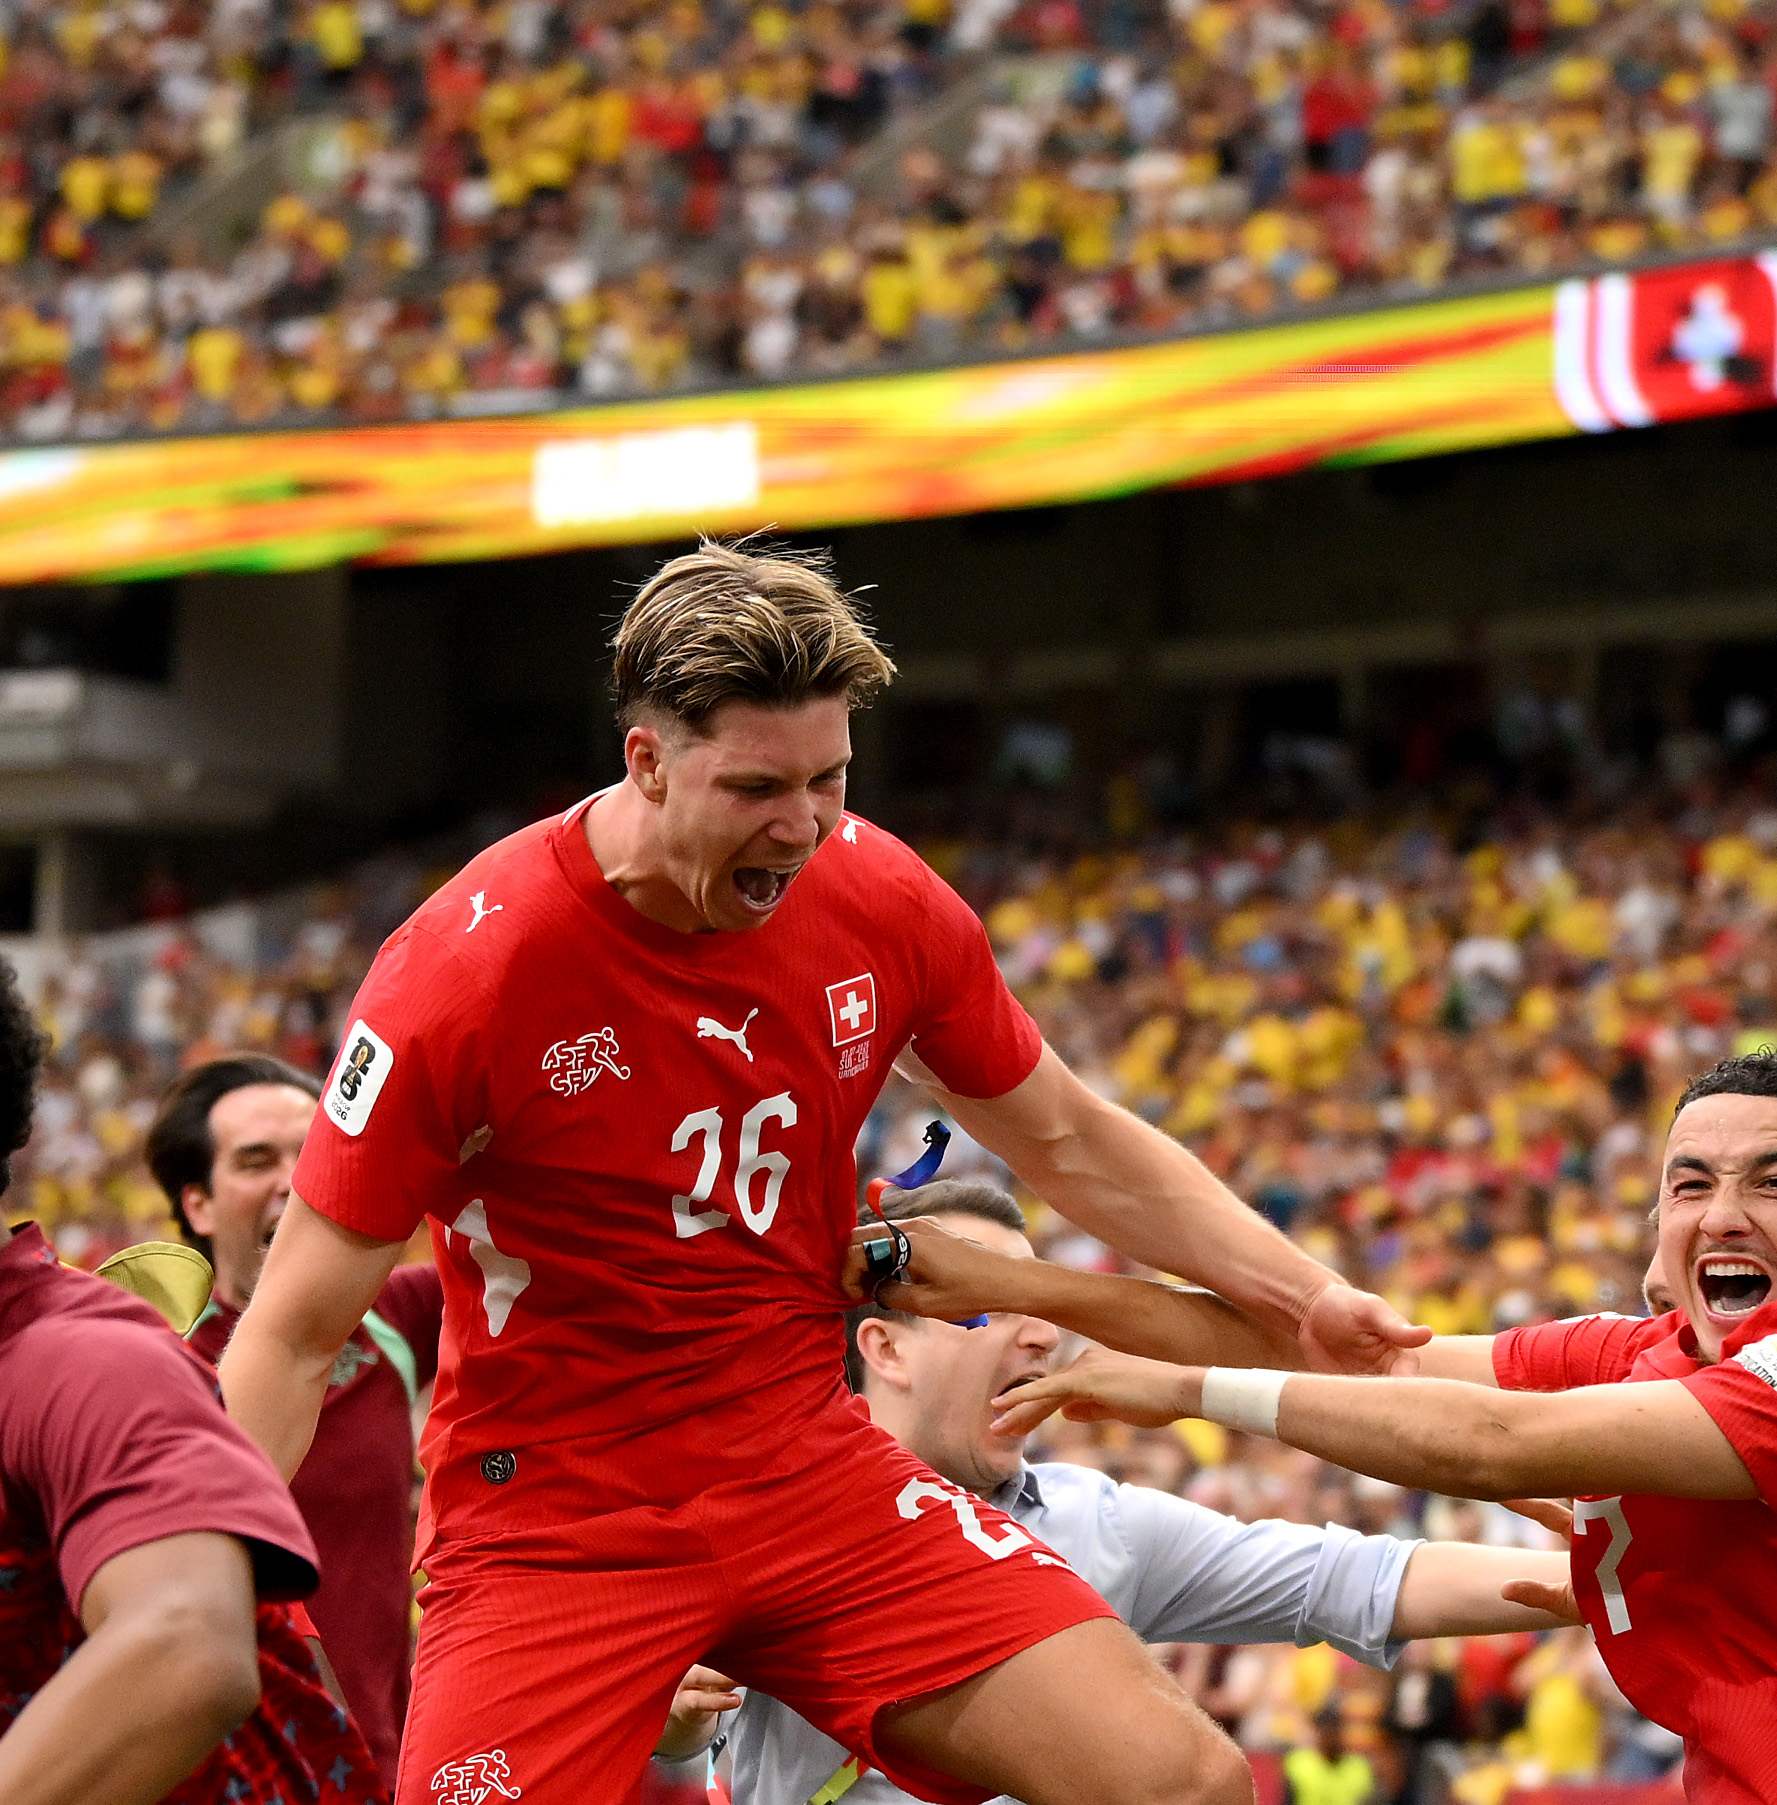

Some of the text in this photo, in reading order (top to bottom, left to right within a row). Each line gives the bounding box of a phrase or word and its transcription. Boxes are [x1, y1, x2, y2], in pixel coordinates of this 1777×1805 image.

[671, 1091, 797, 1238] 26
[896, 1476, 1033, 1560] 2
[1573, 1495, 1633, 1643] 7
